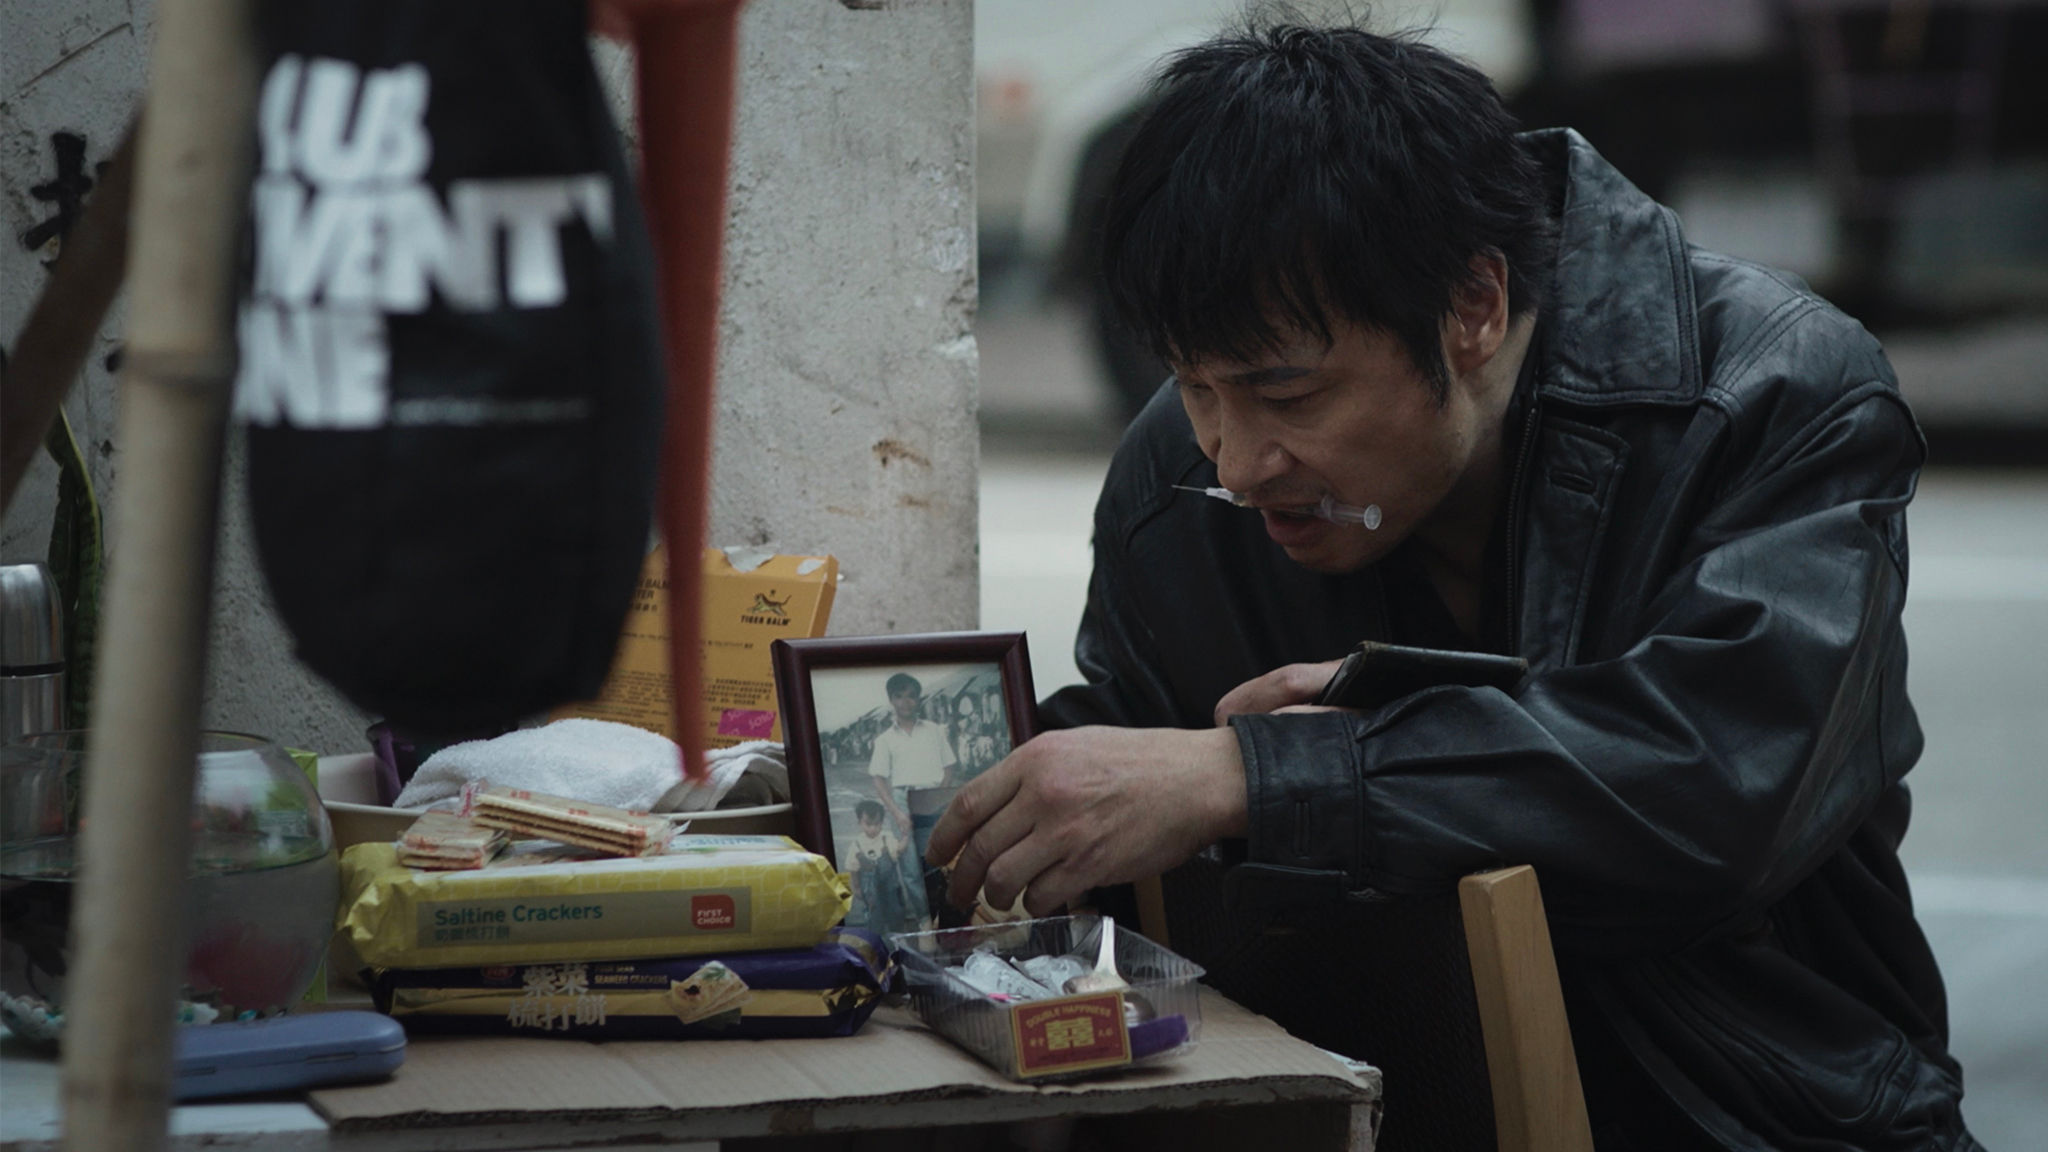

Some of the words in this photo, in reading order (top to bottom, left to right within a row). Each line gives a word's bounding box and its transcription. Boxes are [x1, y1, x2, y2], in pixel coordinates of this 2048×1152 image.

[741, 614, 764, 624] TIGER
[434, 907, 506, 926] Saltine
[512, 903, 603, 922] Crackers
[697, 909, 722, 918] FIRST
[697, 916, 731, 925] CHOICE
[522, 963, 590, 998] 紫菜
[506, 994, 607, 1031] 梳打餅
[1026, 1007, 1059, 1028] DOUBLE
[1061, 1004, 1112, 1018] HAPPINESS
